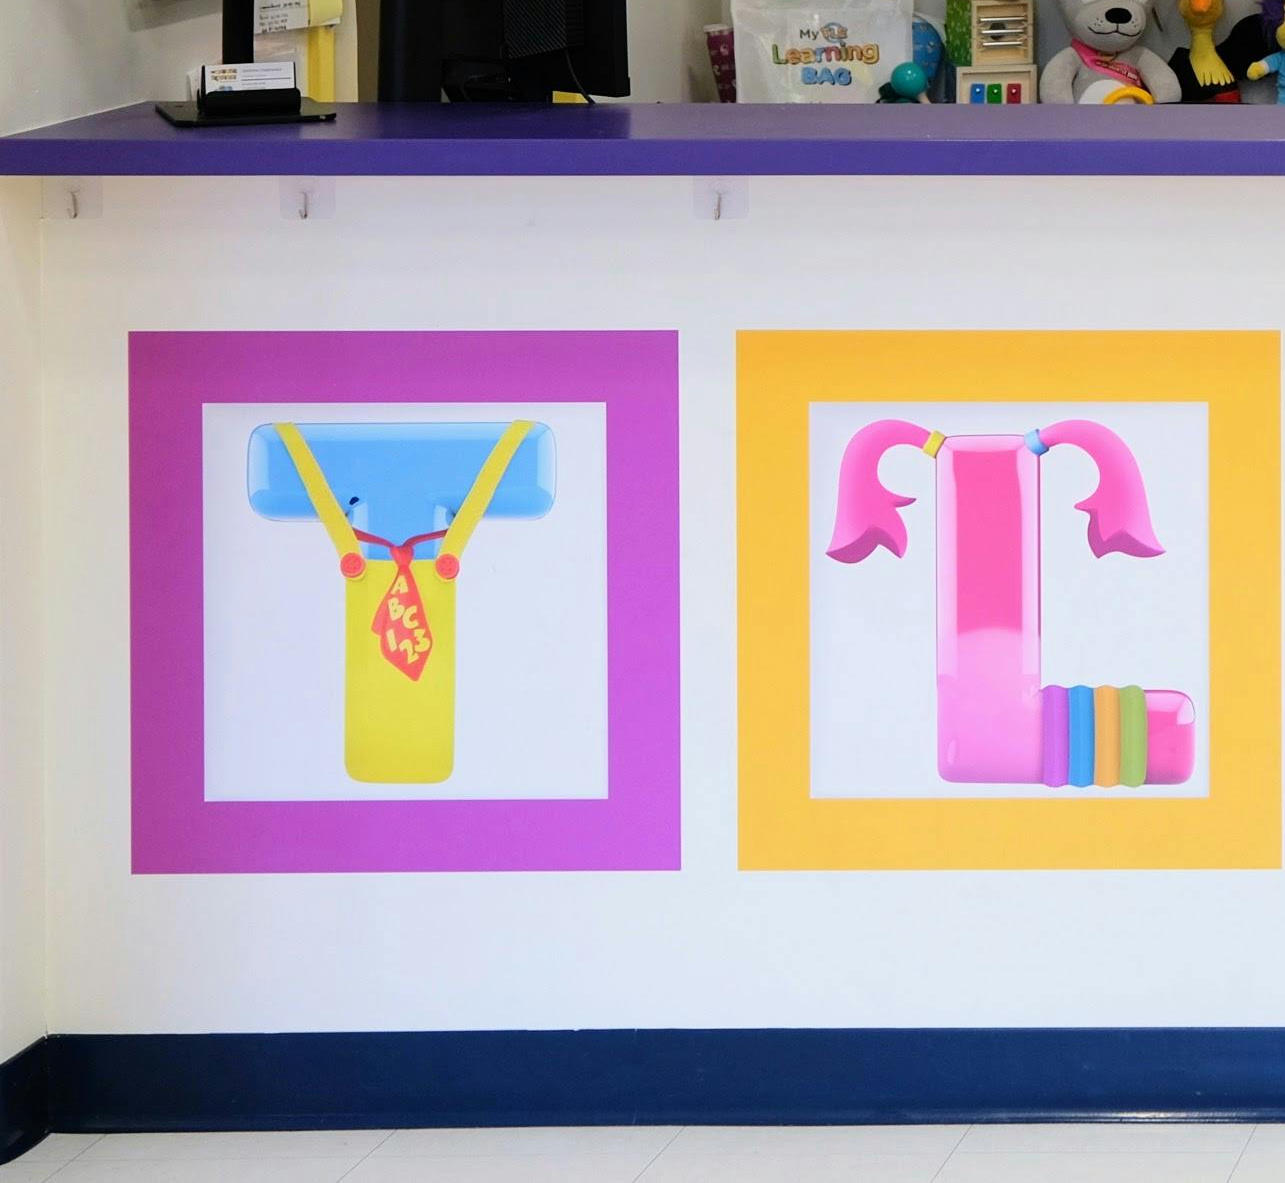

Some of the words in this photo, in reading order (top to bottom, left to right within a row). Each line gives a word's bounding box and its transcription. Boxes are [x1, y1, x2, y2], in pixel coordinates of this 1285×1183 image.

[800, 28, 819, 41] My
[772, 44, 880, 65] Learning
[801, 66, 852, 86] BAG
